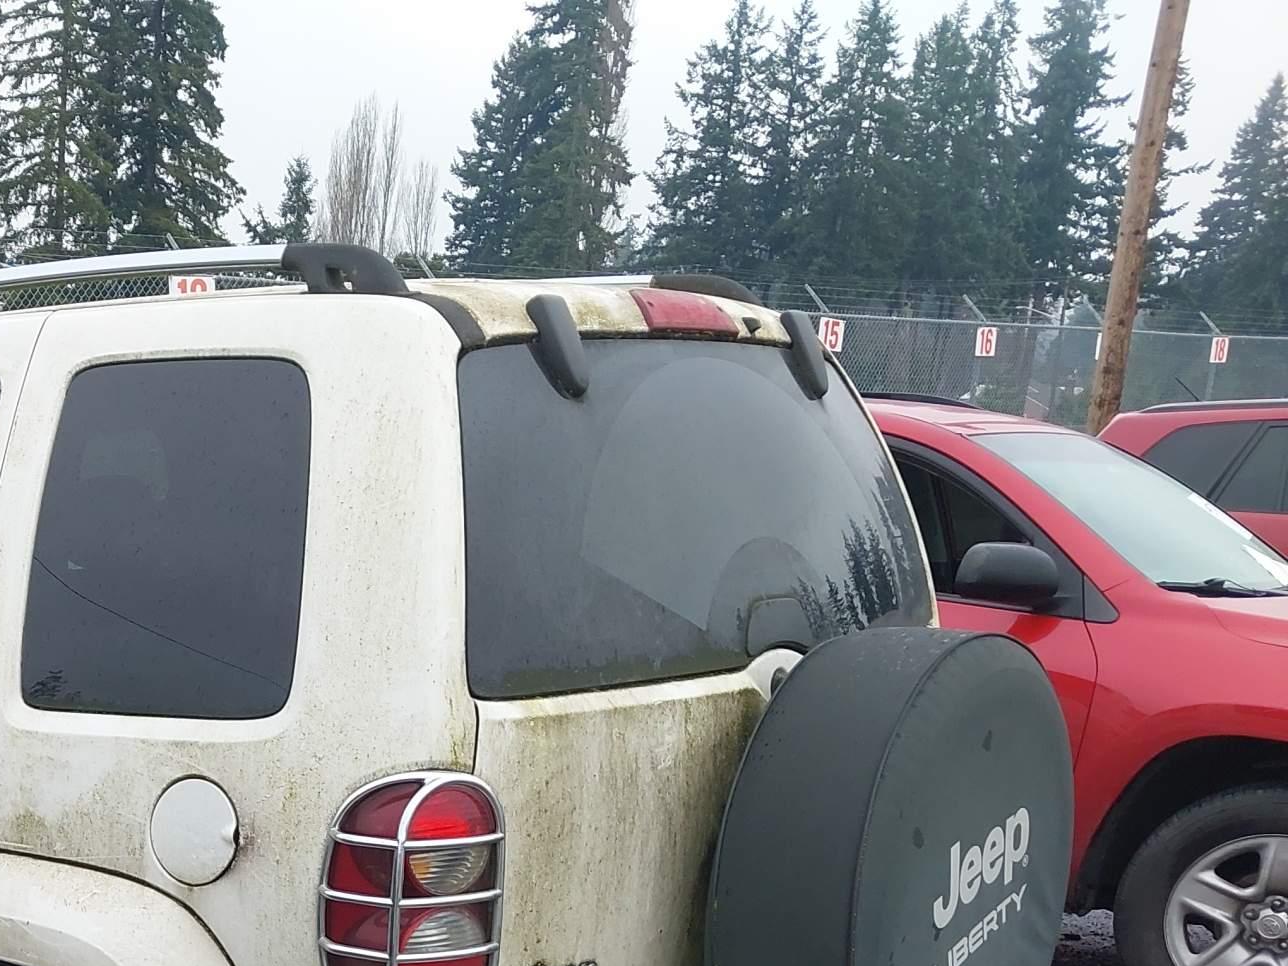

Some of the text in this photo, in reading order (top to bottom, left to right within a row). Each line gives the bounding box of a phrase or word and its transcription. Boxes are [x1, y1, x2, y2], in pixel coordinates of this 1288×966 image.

[822, 320, 840, 349] 15
[979, 328, 993, 354] 16
[1214, 338, 1227, 361] 18
[933, 807, 1030, 928] Jeep
